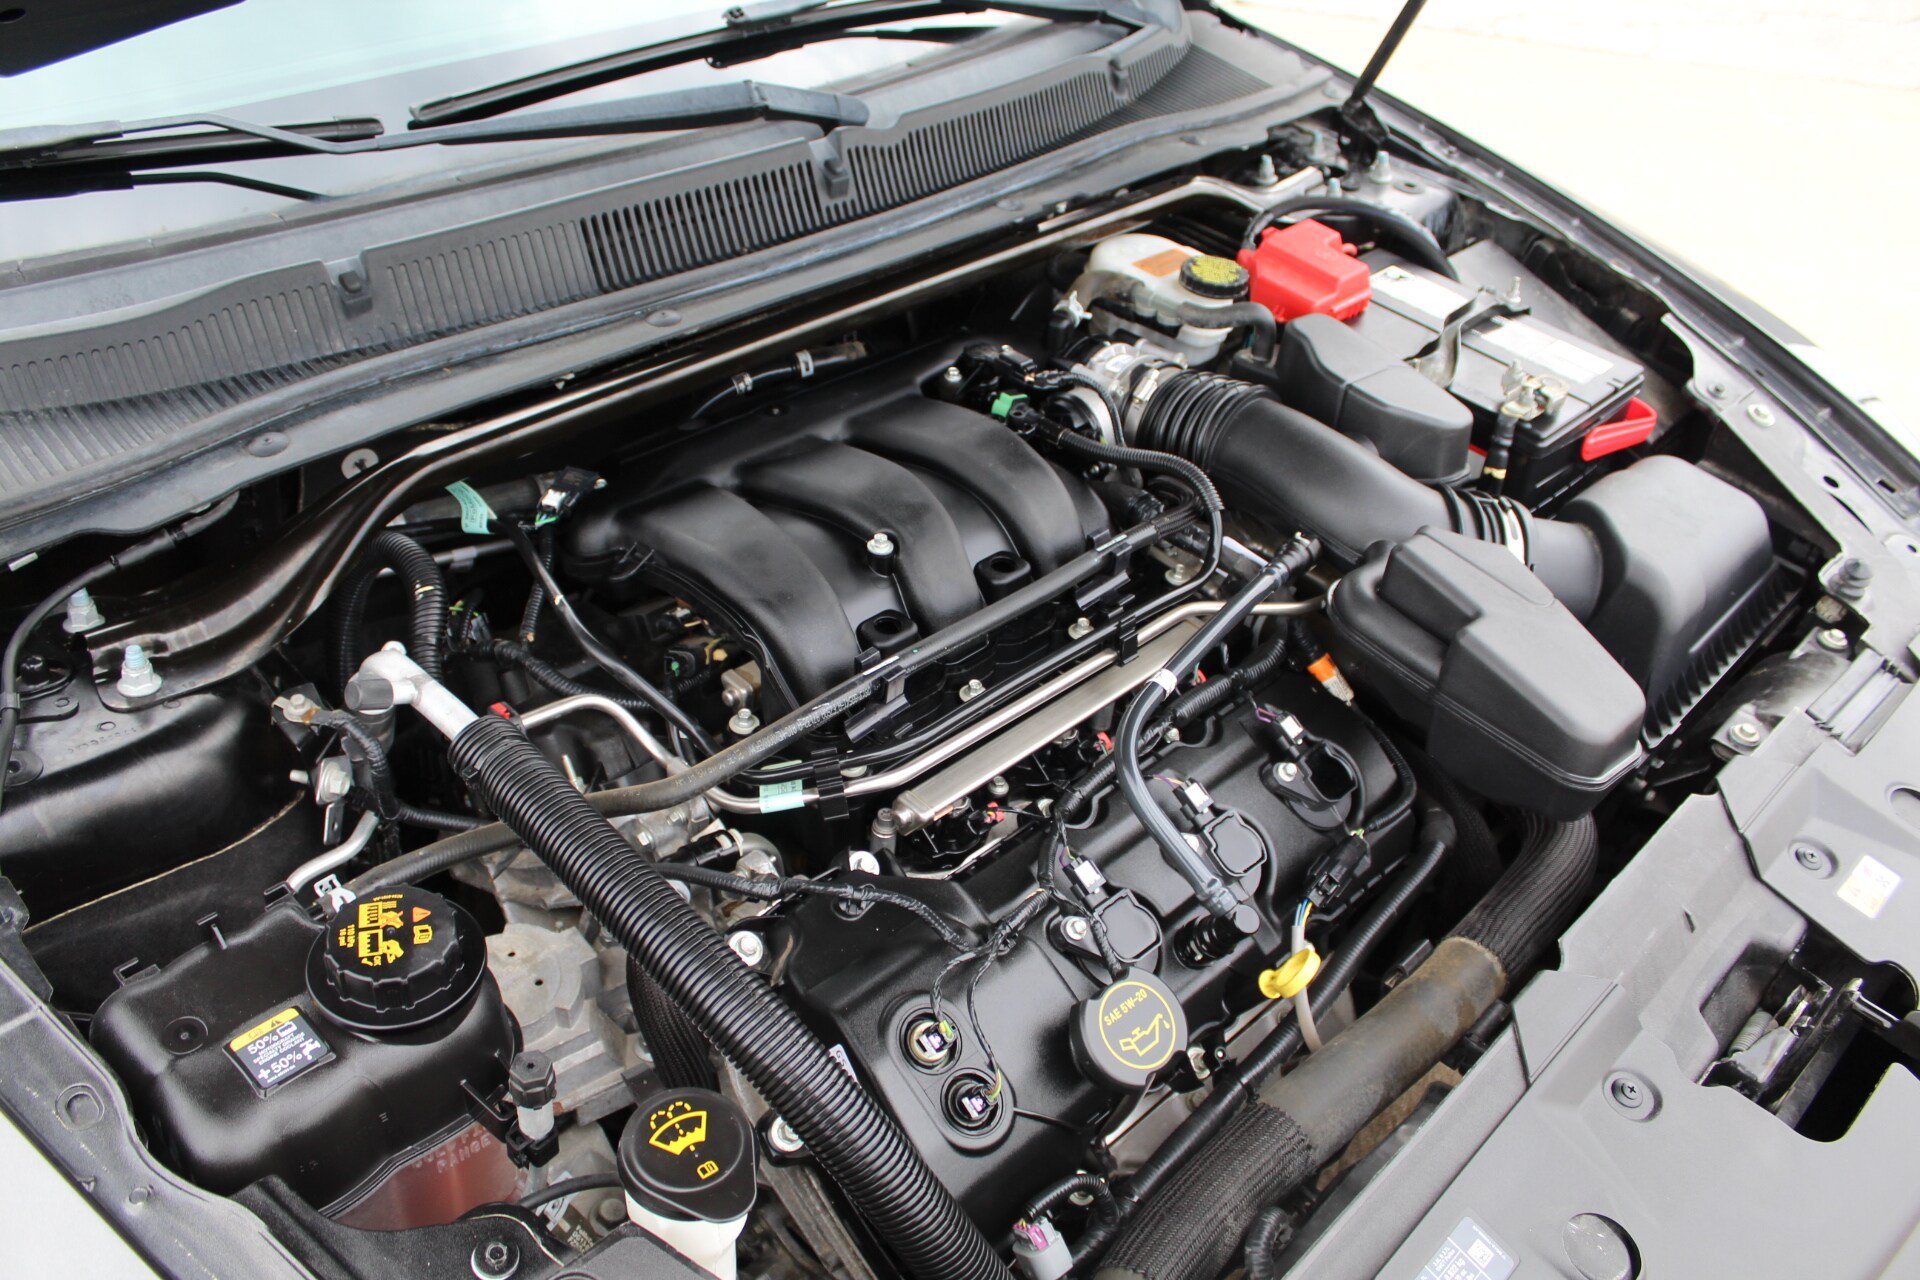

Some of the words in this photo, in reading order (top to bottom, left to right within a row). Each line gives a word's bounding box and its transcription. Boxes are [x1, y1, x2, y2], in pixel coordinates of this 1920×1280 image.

[1104, 1007, 1122, 1026] SAE
[1120, 988, 1148, 1014] 5W-20
[247, 1033, 278, 1055] 50%
[271, 1050, 303, 1074] 50%
